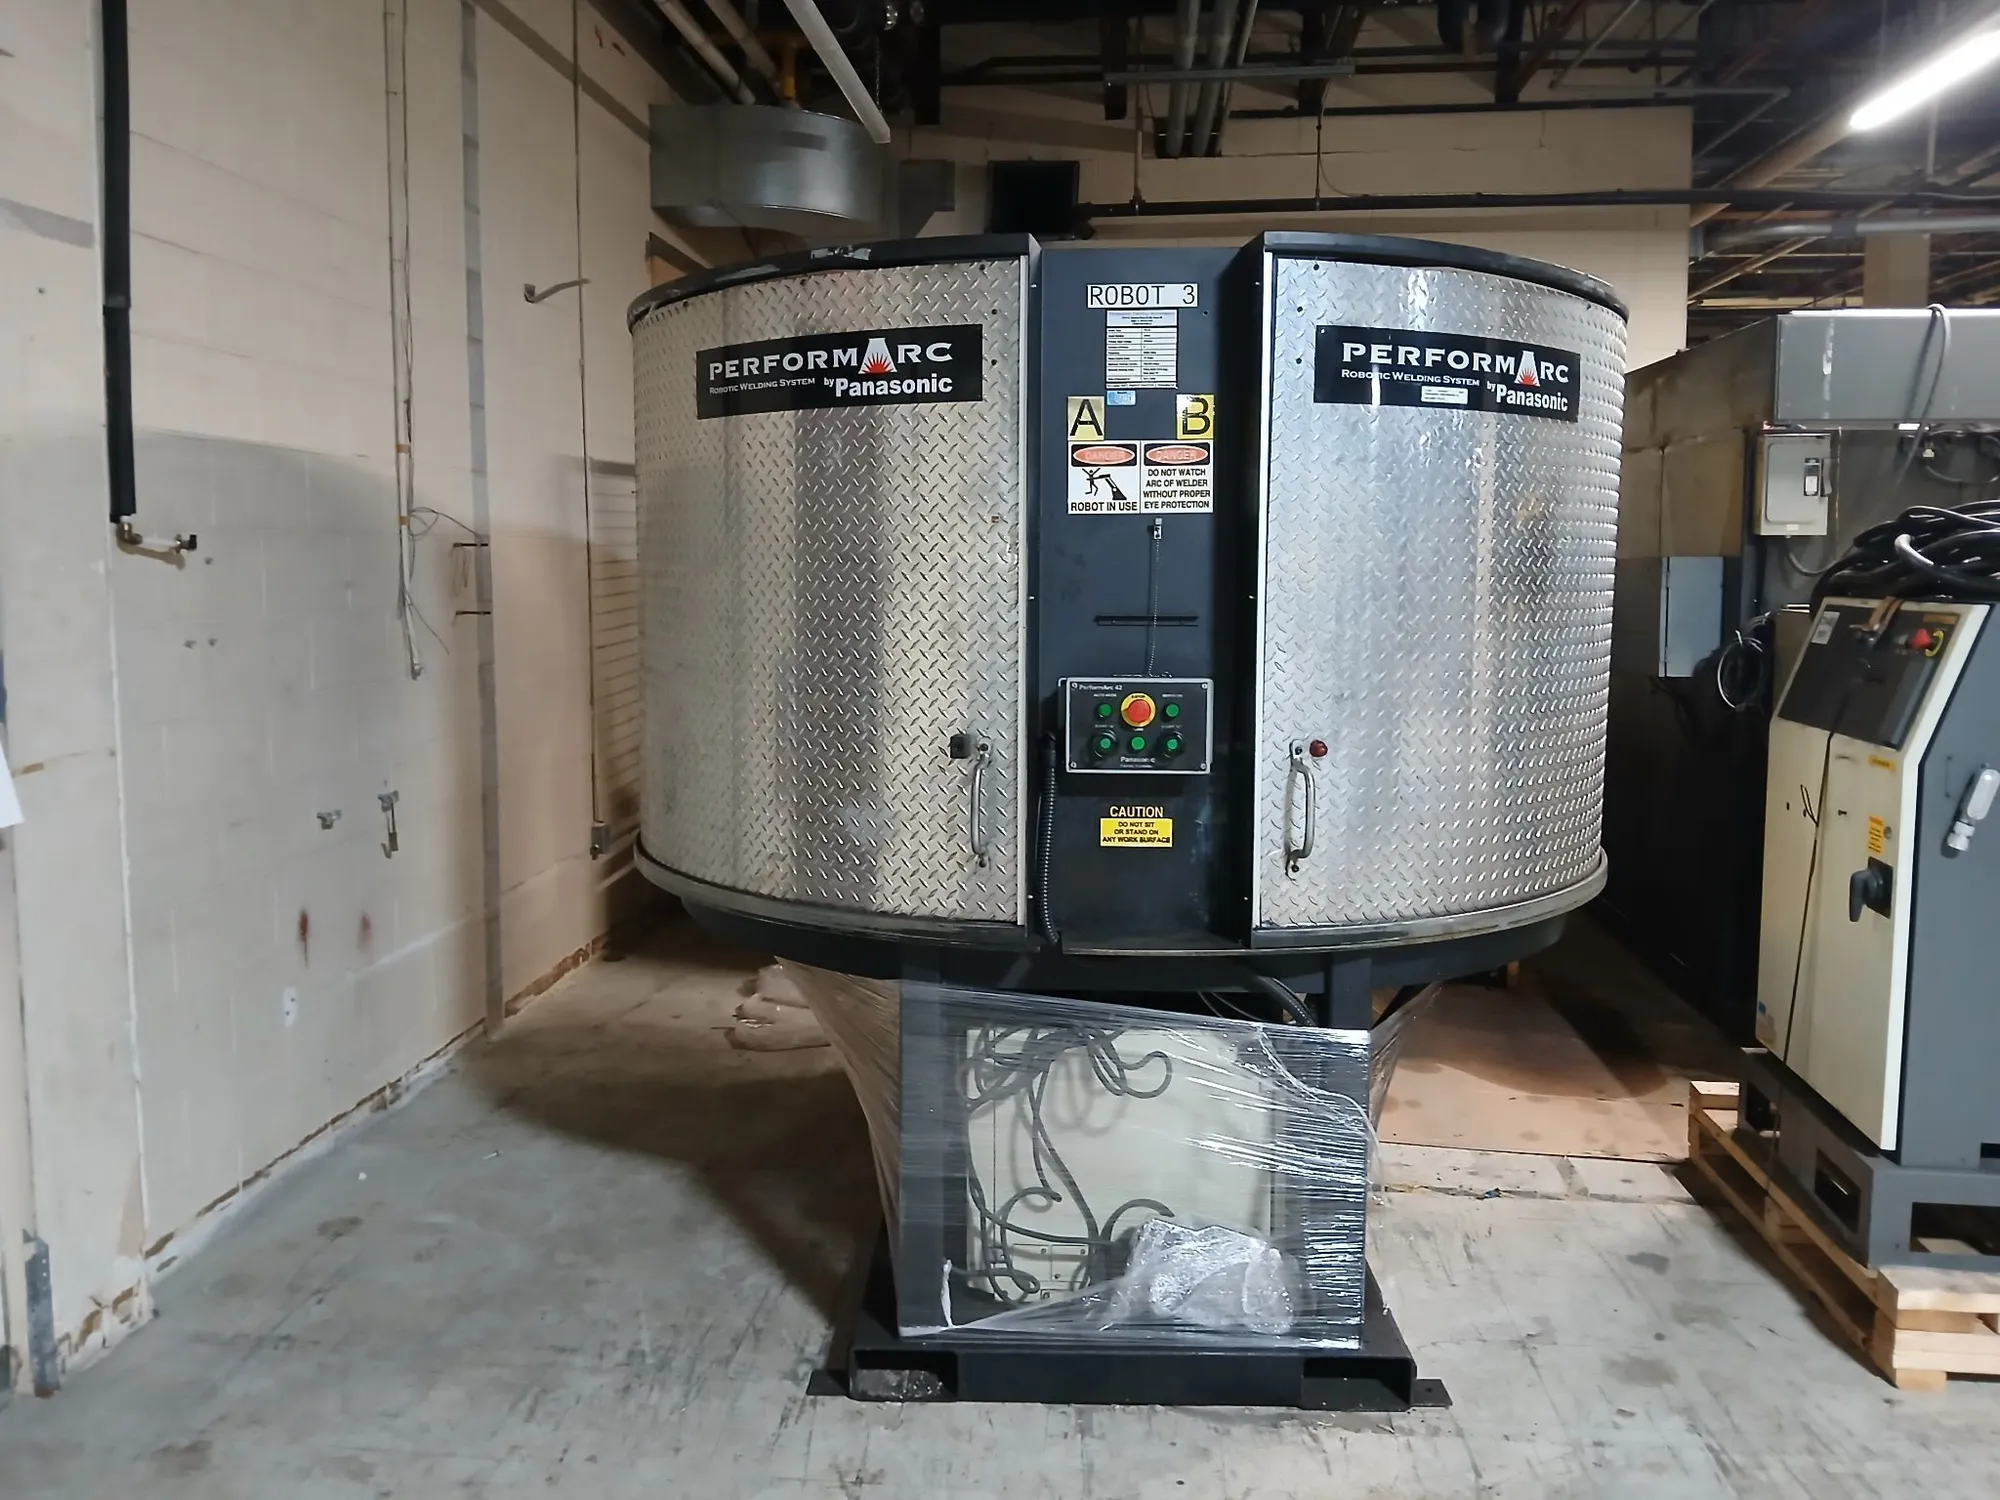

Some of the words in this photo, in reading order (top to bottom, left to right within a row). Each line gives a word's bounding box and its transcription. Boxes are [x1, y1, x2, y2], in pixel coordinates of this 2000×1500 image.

[1090, 285, 1165, 306] ROBOT
[1182, 284, 1195, 305] 3
[709, 337, 953, 381] PERFORMARC
[1341, 342, 1569, 387] PERFORMARC
[709, 383, 739, 395] ROBOTIC
[739, 381, 778, 392] WELDING
[779, 377, 816, 387] SYSTEM
[823, 376, 834, 388] by
[835, 373, 953, 398] Panasonic
[1341, 369, 1391, 380] ROBOIC
[1391, 371, 1442, 383] WELDING
[1442, 375, 1480, 387] SYSTEM
[1486, 381, 1496, 393] by
[1496, 384, 1568, 412] Panasonic
[1069, 398, 1104, 436] A
[1182, 396, 1211, 436] B
[1147, 469, 1159, 477] DO
[1160, 468, 1177, 477] NOT
[1178, 468, 1206, 477] WATCH
[1176, 479, 1208, 487] WELDER
[1143, 490, 1178, 498] WITHOUT
[1179, 490, 1211, 498] PROPER
[1071, 502, 1104, 511] ROBOT
[1106, 502, 1116, 511] IN
[1118, 501, 1138, 511] USE
[1144, 501, 1159, 509] EYE
[1160, 501, 1210, 509] PROTECTION
[1109, 806, 1164, 818] CAUTION
